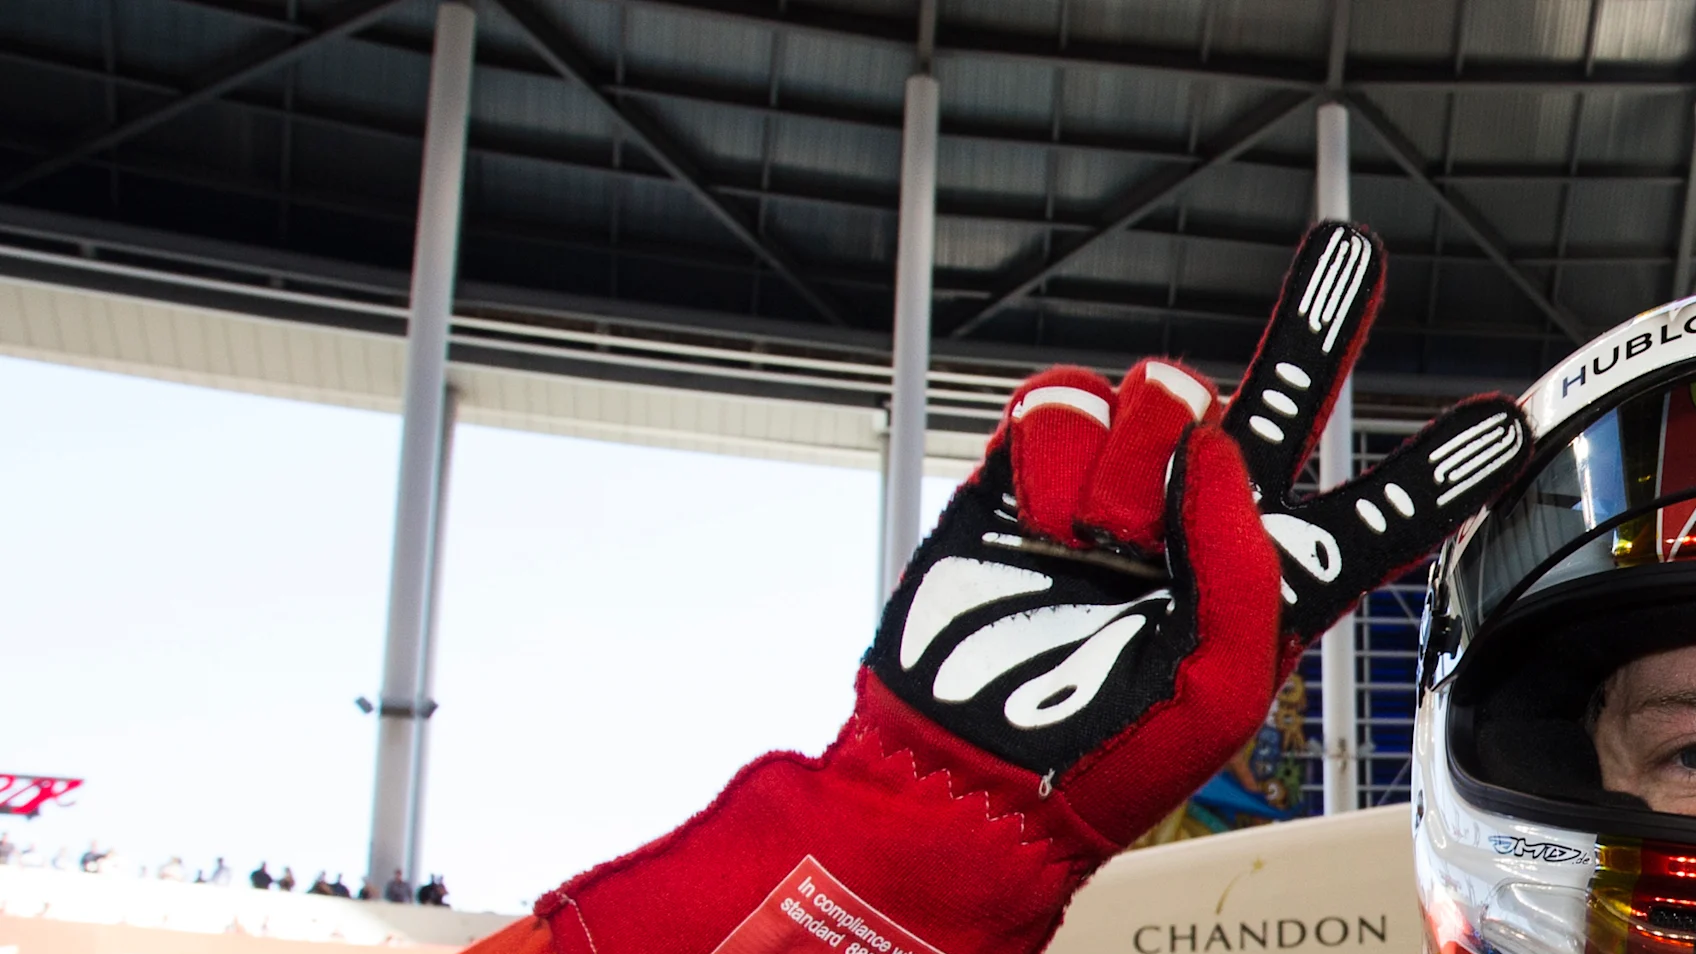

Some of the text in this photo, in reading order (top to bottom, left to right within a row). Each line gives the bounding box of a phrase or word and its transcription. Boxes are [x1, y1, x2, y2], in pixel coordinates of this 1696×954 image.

[781, 897, 845, 948] standard
[797, 876, 815, 898] In
[813, 893, 891, 952] compliance
